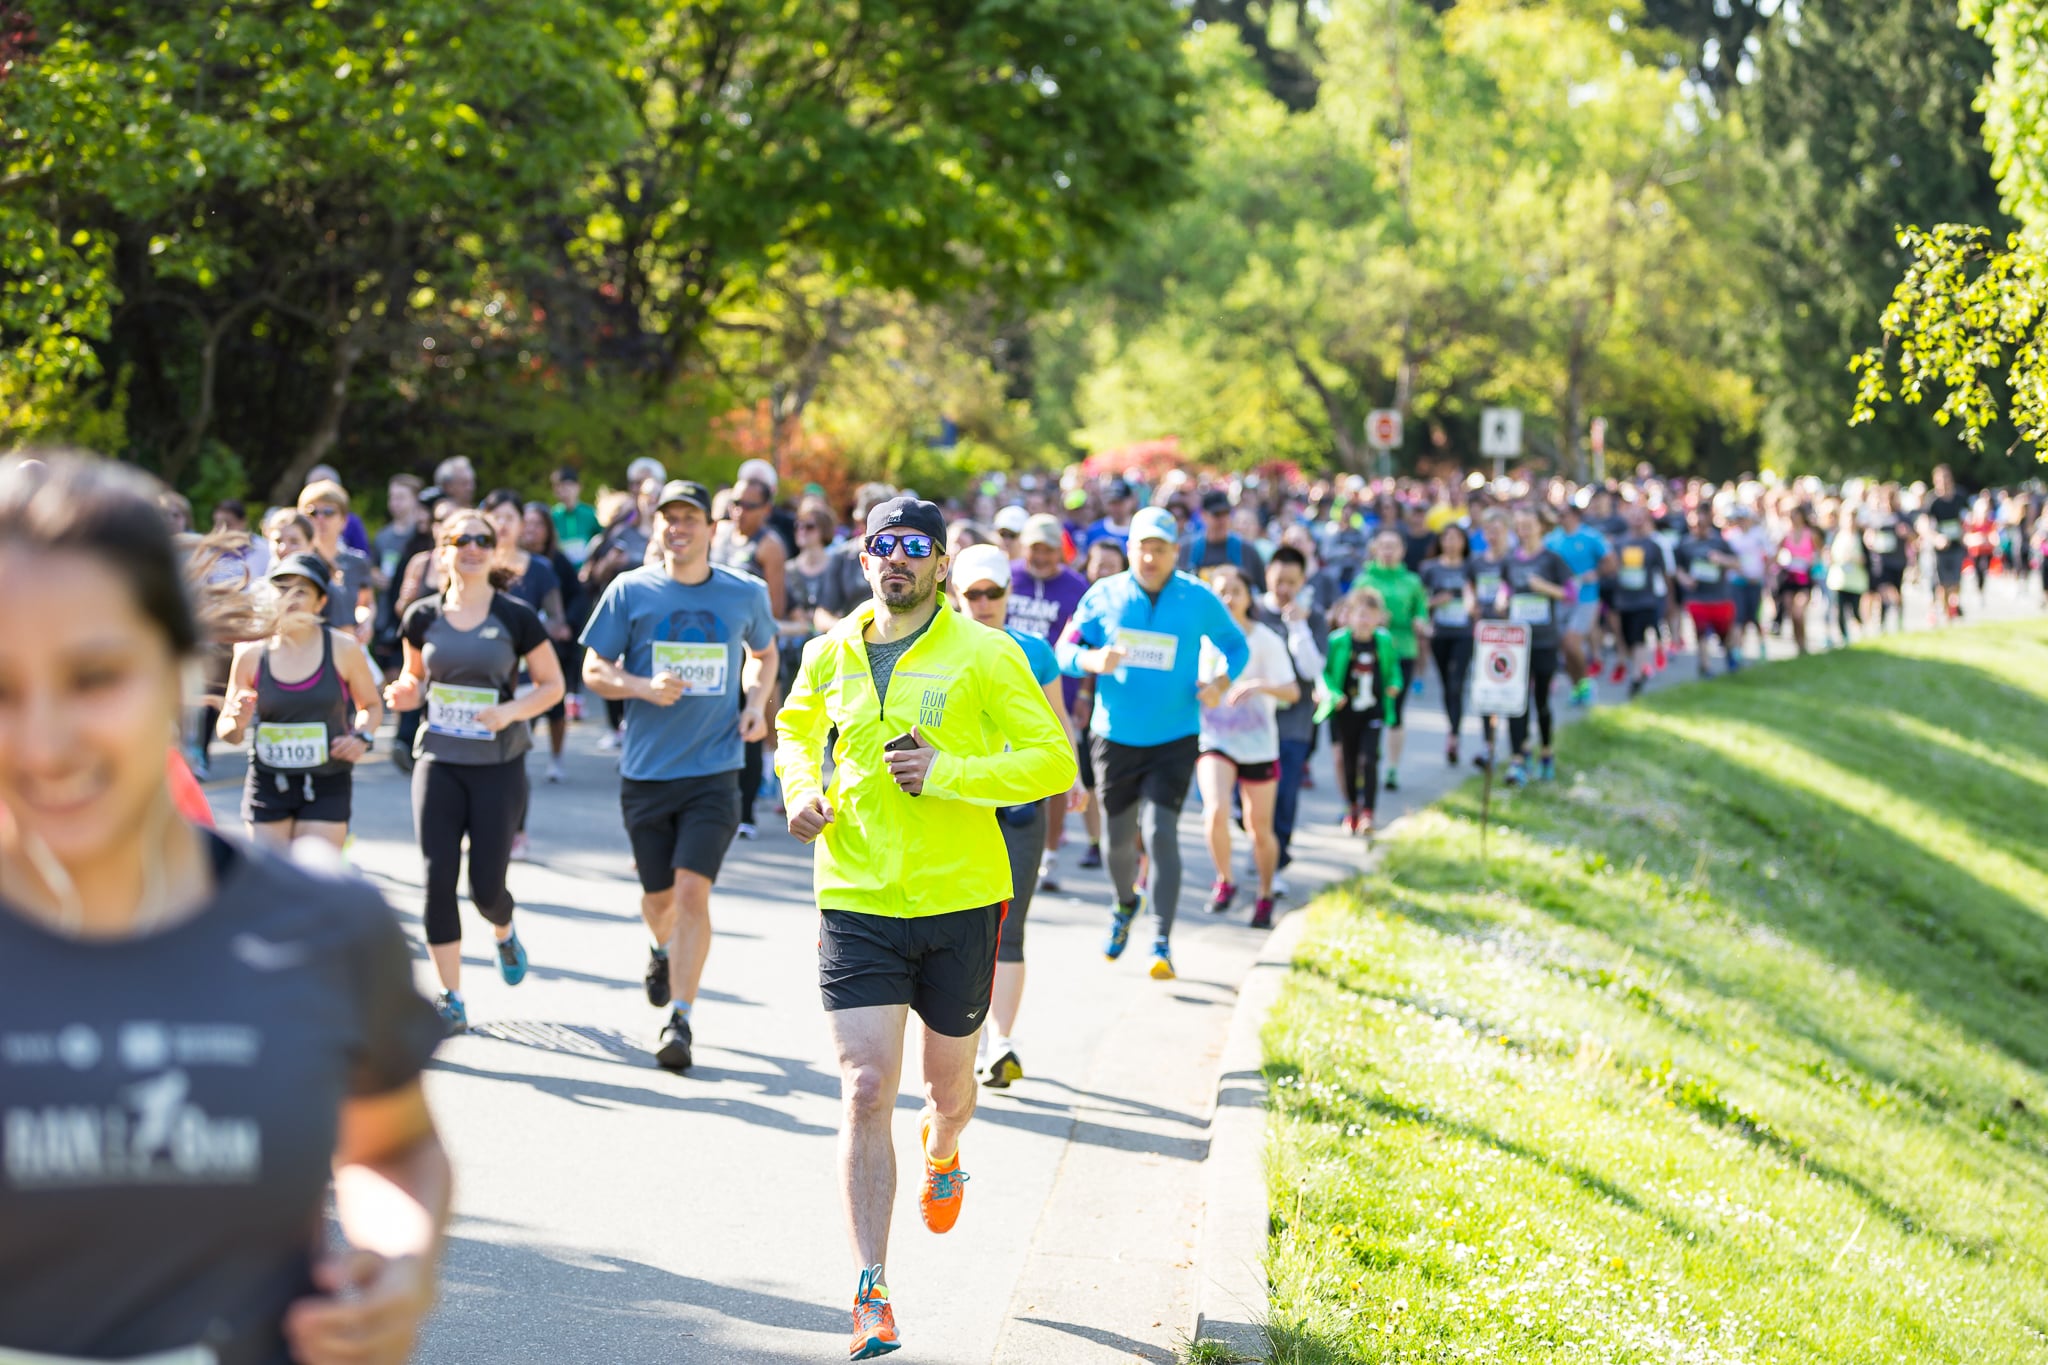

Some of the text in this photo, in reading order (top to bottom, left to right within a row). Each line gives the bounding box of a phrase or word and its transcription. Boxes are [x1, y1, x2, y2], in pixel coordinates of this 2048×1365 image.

[922, 690, 947, 709] RUN
[919, 709, 943, 728] VAN
[266, 744, 314, 761] 33103
